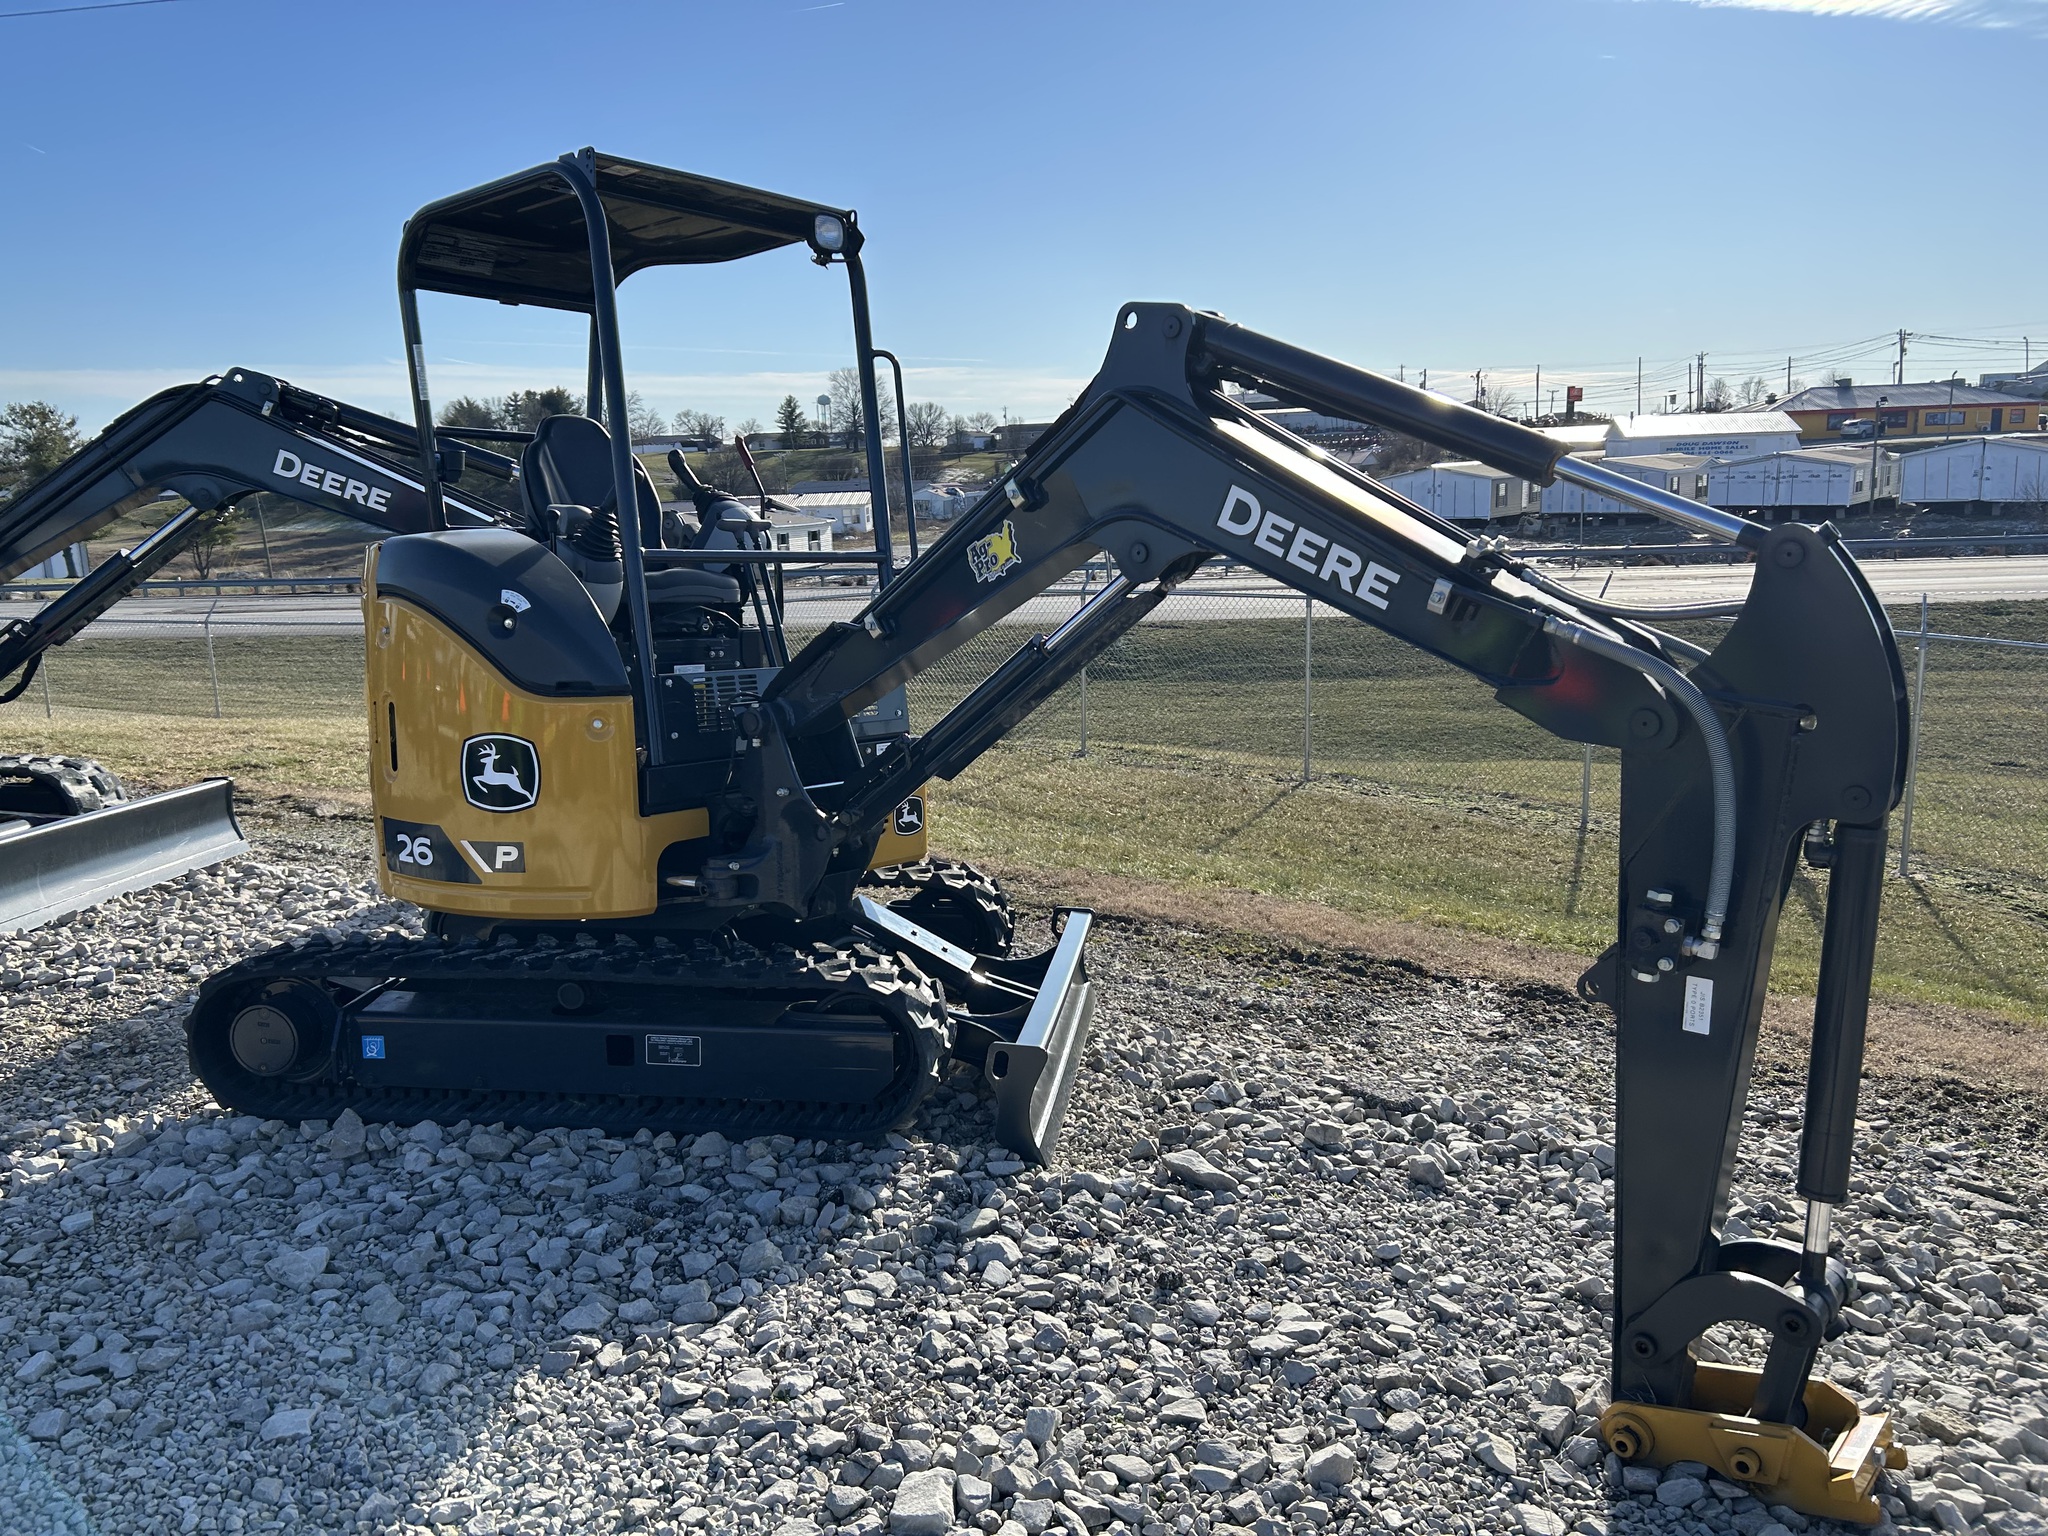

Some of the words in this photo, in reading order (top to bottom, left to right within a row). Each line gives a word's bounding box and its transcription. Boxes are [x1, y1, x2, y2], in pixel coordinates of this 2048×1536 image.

[273, 449, 391, 512] DEERE
[1216, 484, 1401, 610] DEERE
[975, 553, 998, 578] Pro
[397, 833, 434, 866] 26
[494, 845, 519, 869] P
[1688, 1005, 1697, 1027] PORTS
